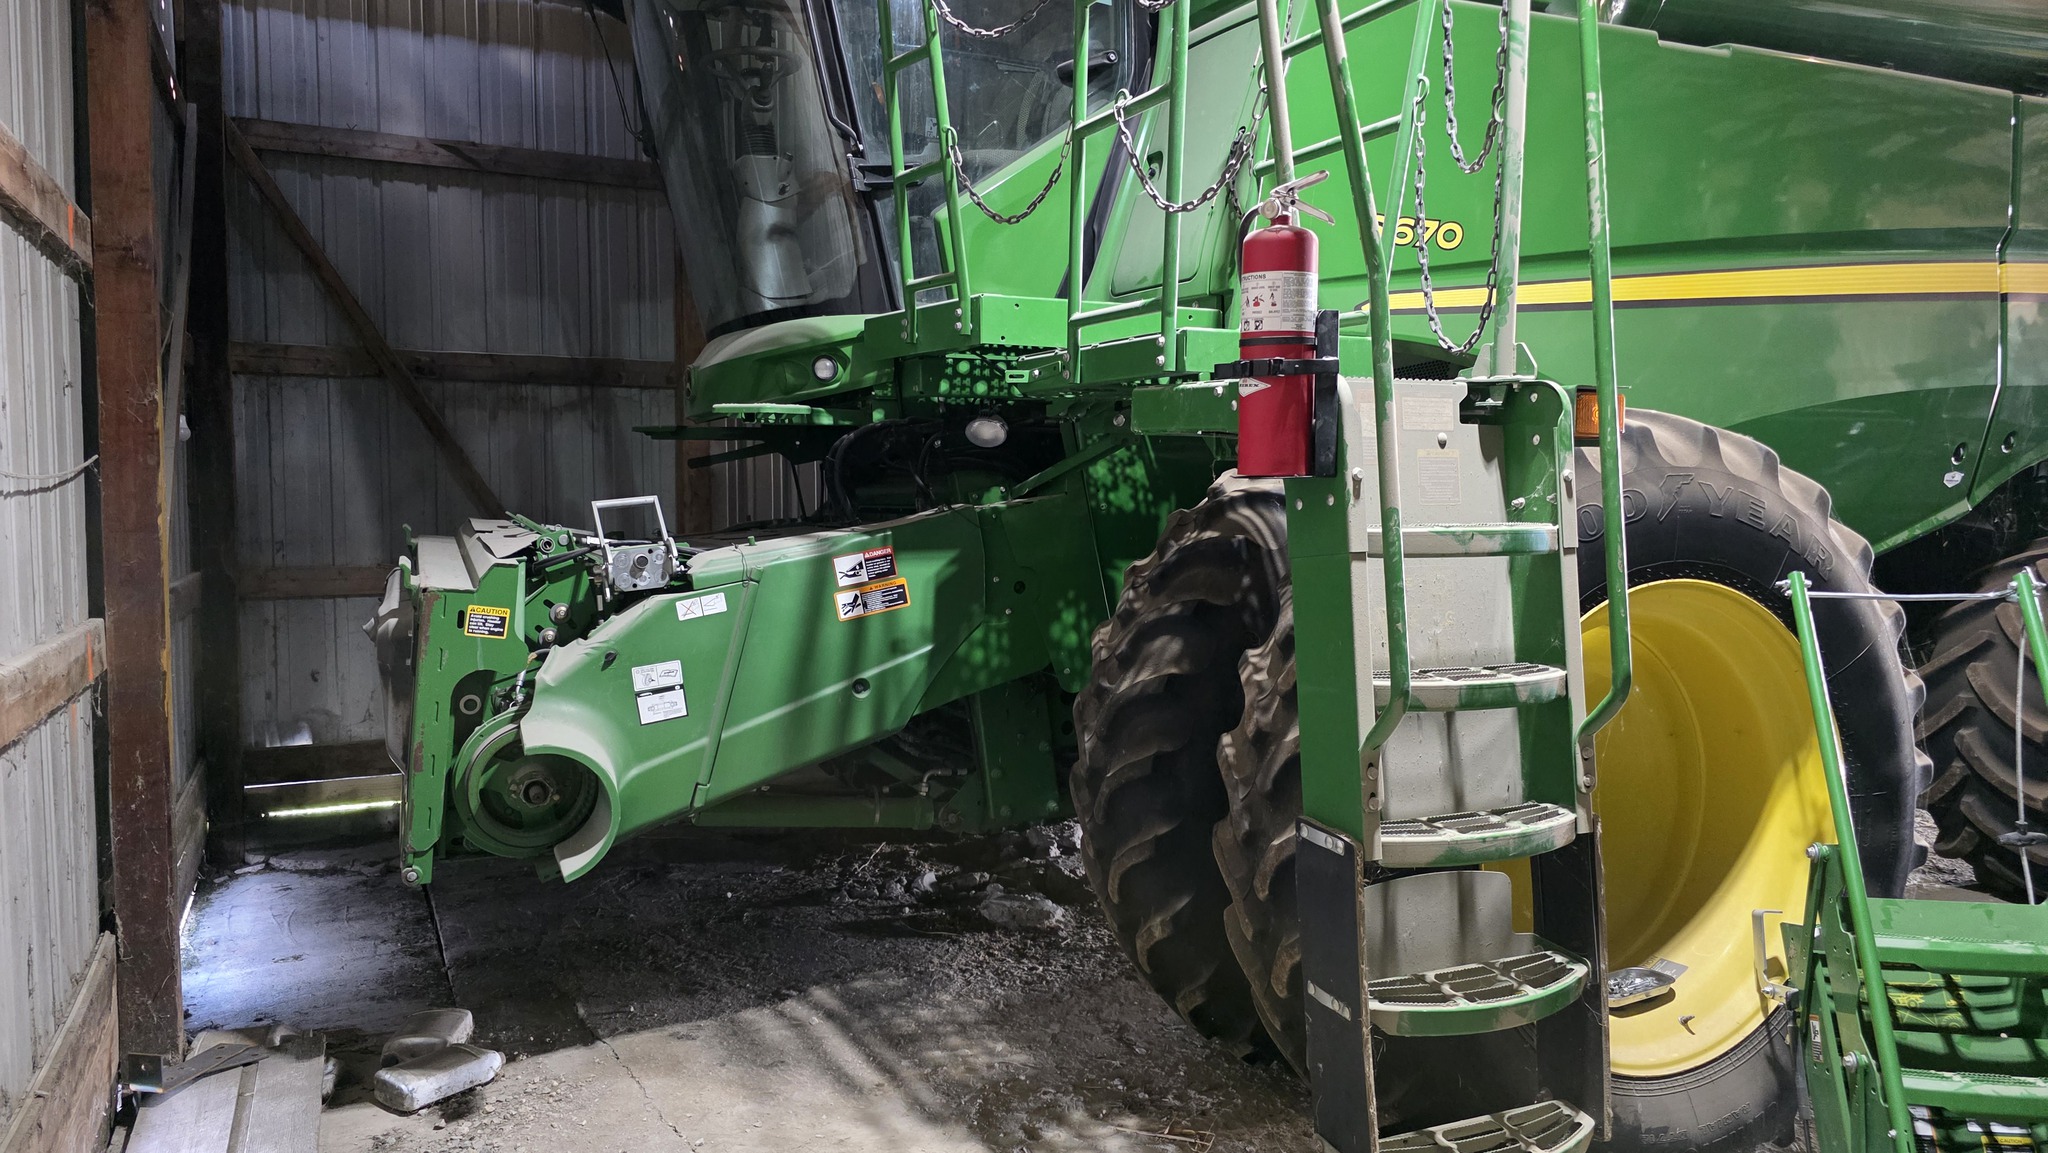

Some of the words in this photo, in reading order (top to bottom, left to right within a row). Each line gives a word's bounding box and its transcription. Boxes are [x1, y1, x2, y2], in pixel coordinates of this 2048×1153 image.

[1698, 480, 1836, 581] YEAR
[869, 548, 891, 557] DANGER
[874, 581, 896, 589] WARNING
[476, 607, 508, 615] CAUTION
